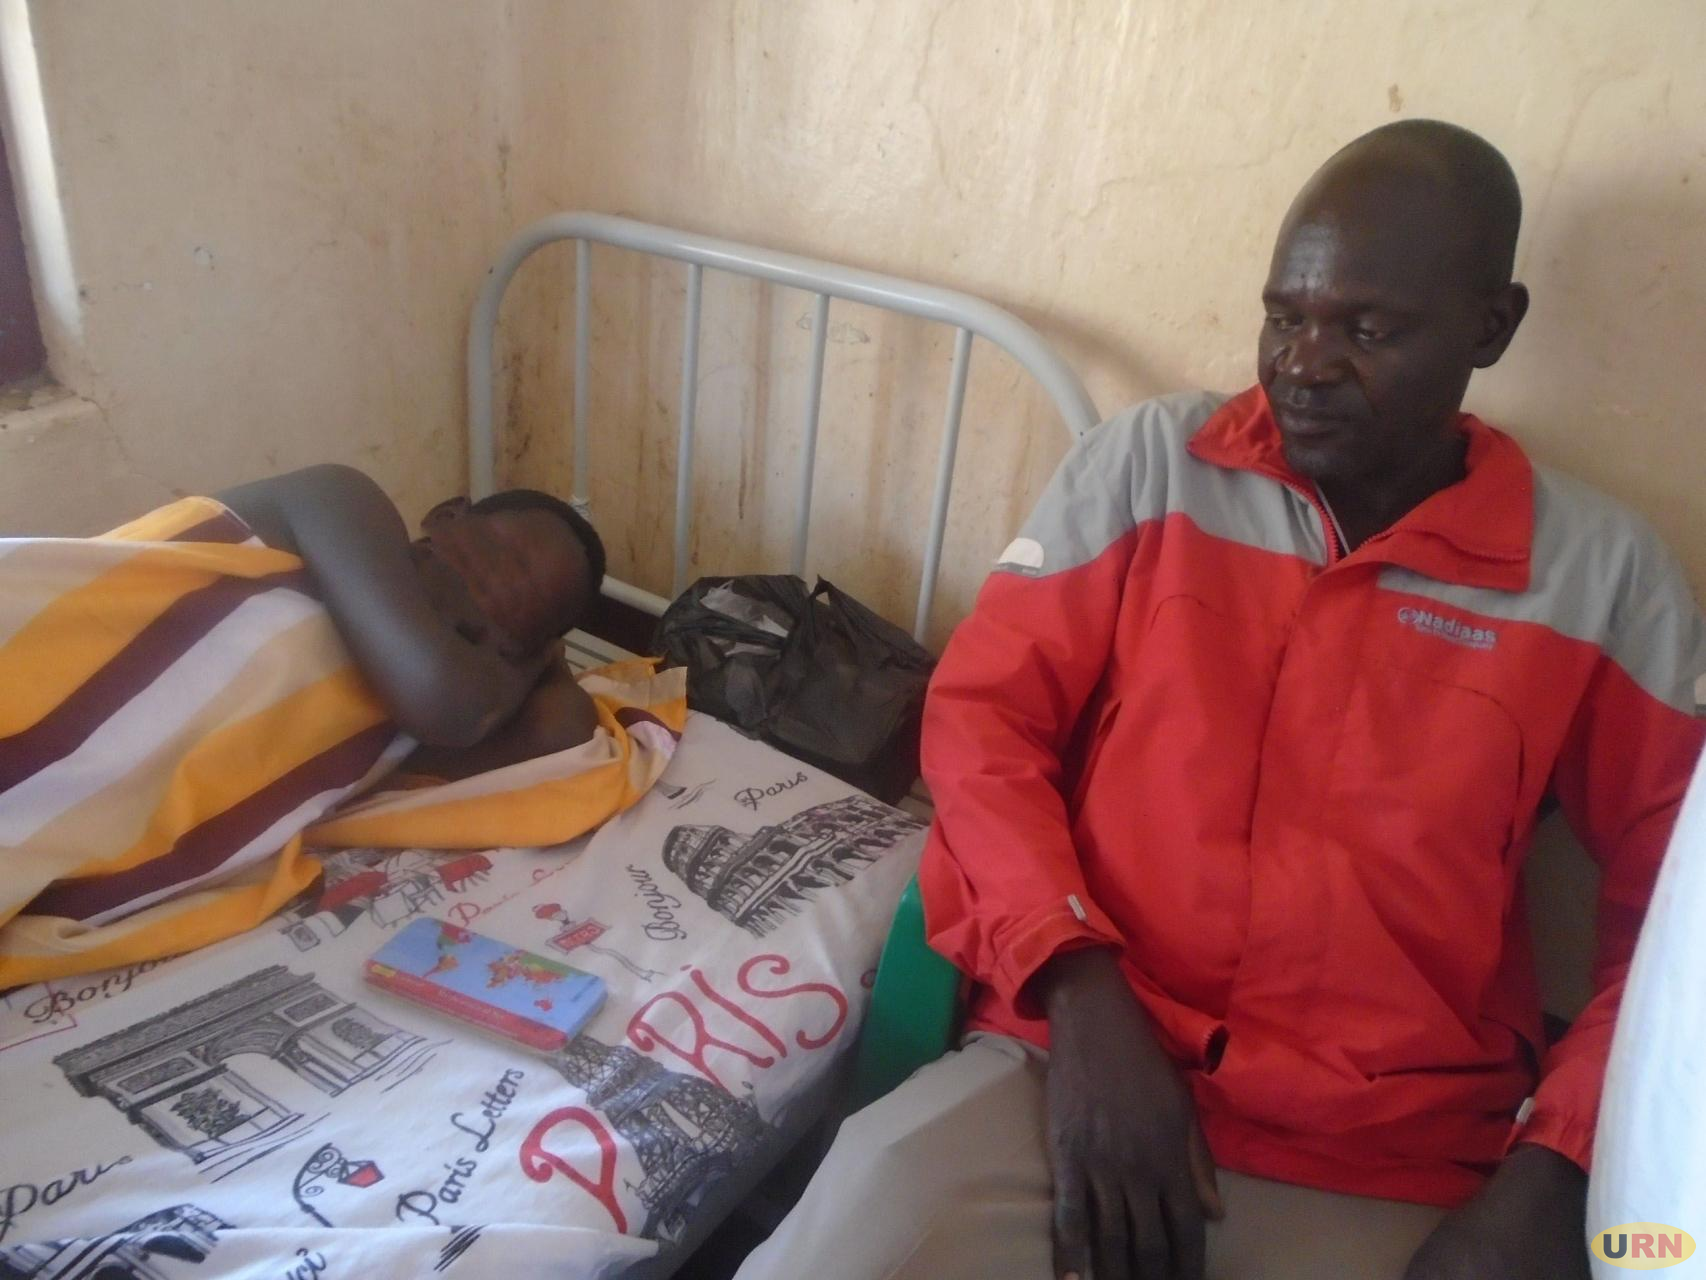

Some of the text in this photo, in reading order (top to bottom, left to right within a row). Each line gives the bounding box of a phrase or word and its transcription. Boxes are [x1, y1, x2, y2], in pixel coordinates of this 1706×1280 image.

[734, 772, 808, 811] Paris
[626, 864, 687, 941] Bonjour
[24, 955, 172, 1024] Bonjo
[396, 1157, 476, 1225] Paris
[451, 1067, 524, 1151] Letters
